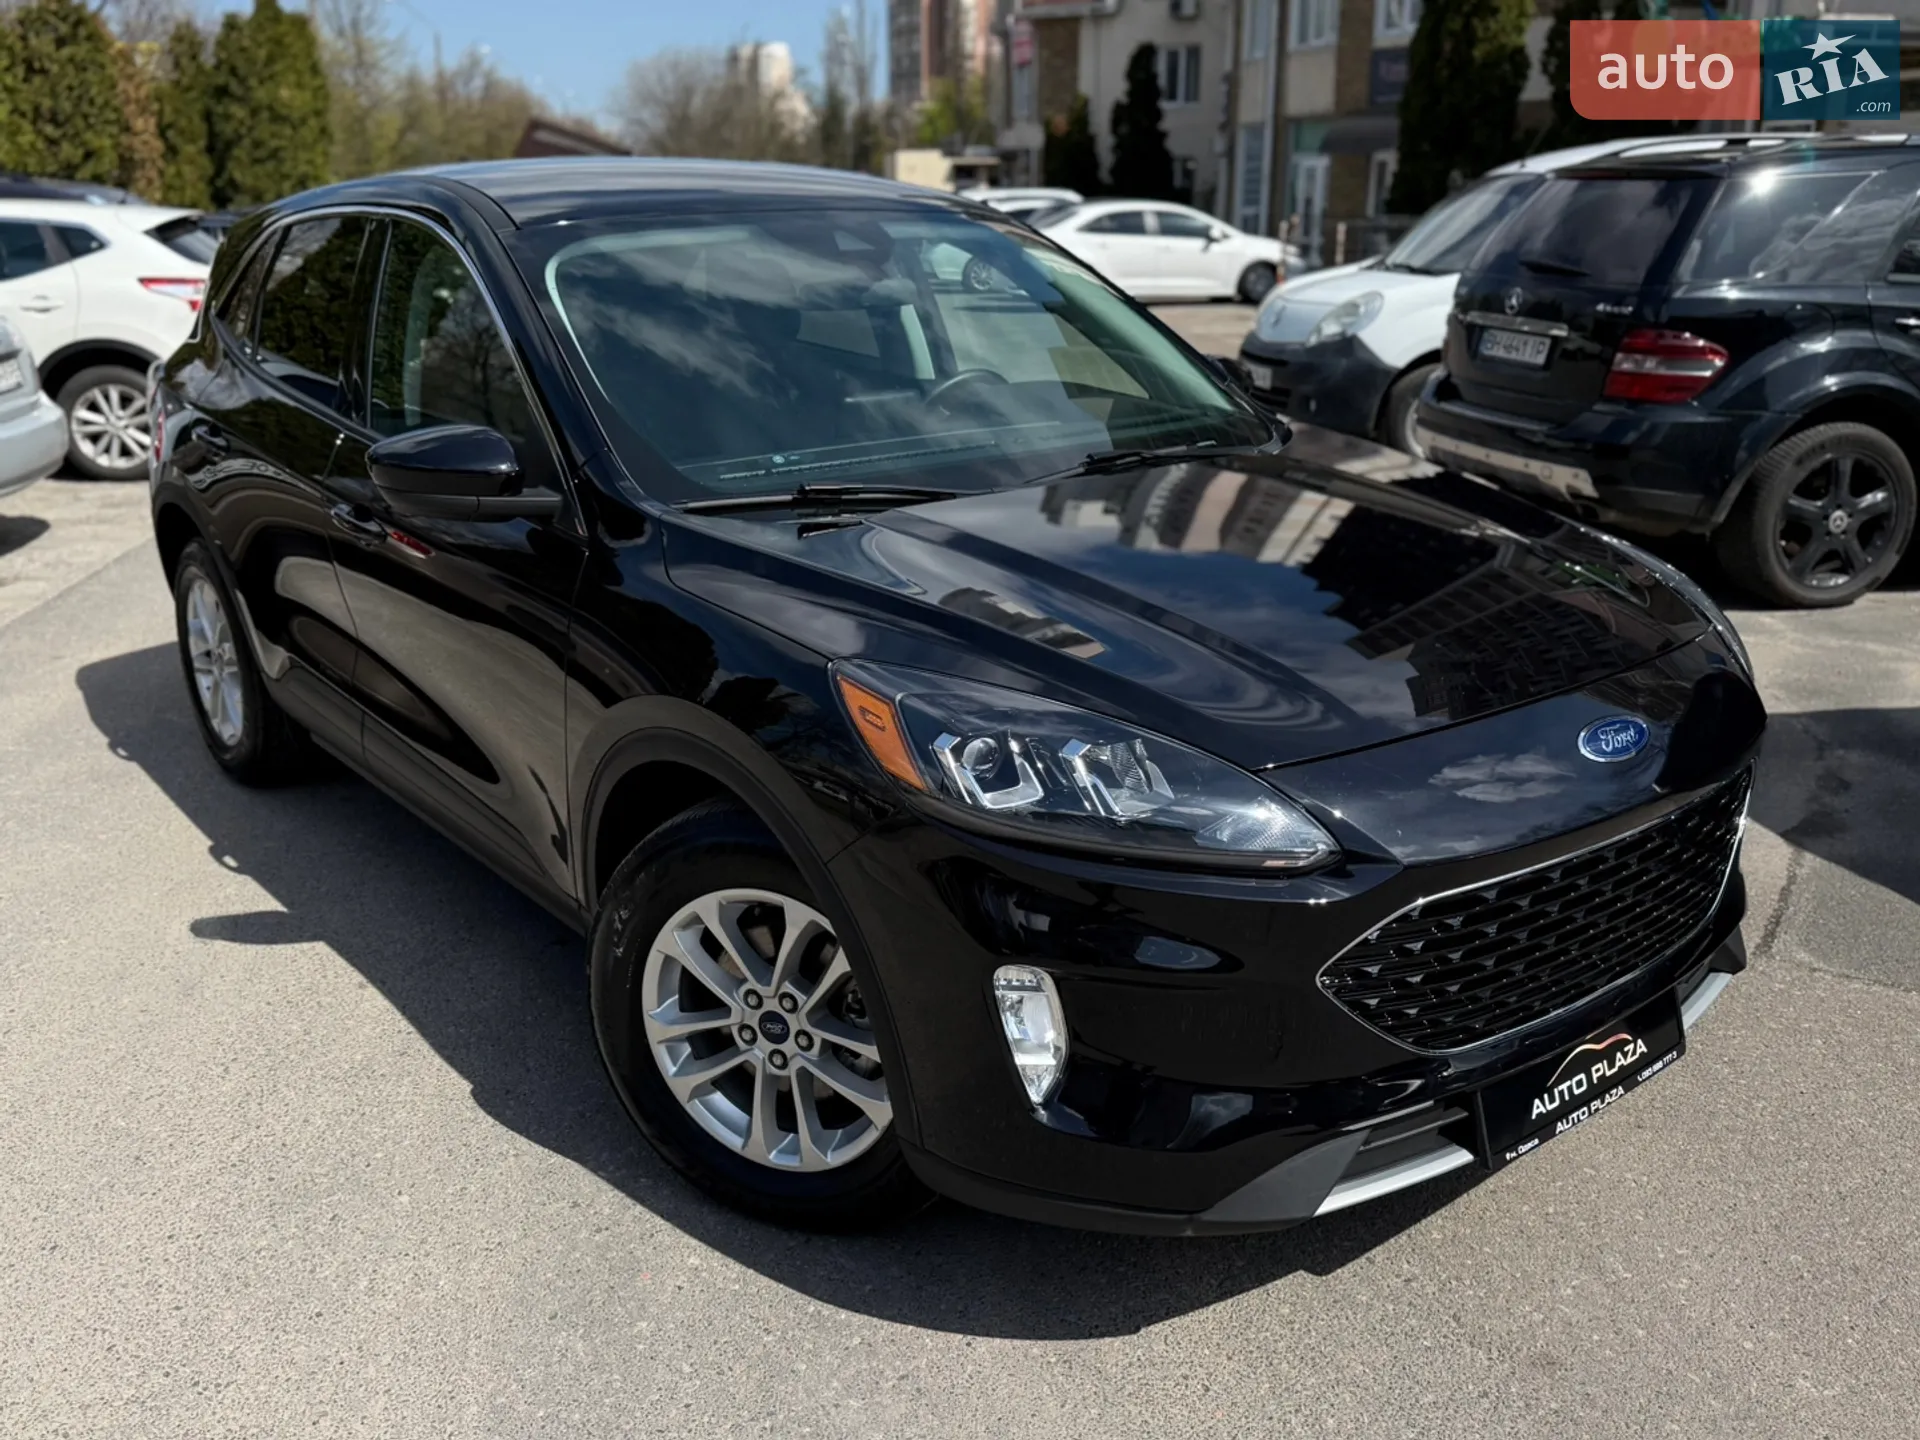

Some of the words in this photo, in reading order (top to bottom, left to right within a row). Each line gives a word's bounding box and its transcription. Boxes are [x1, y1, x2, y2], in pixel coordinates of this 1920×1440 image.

[1596, 723, 1639, 753] Ford
[1531, 1071, 1587, 1120] AUTO
[1592, 1038, 1648, 1085] PLAZA
[1555, 1106, 1589, 1135] AUTO
[1590, 1085, 1625, 1114] PLAZA
